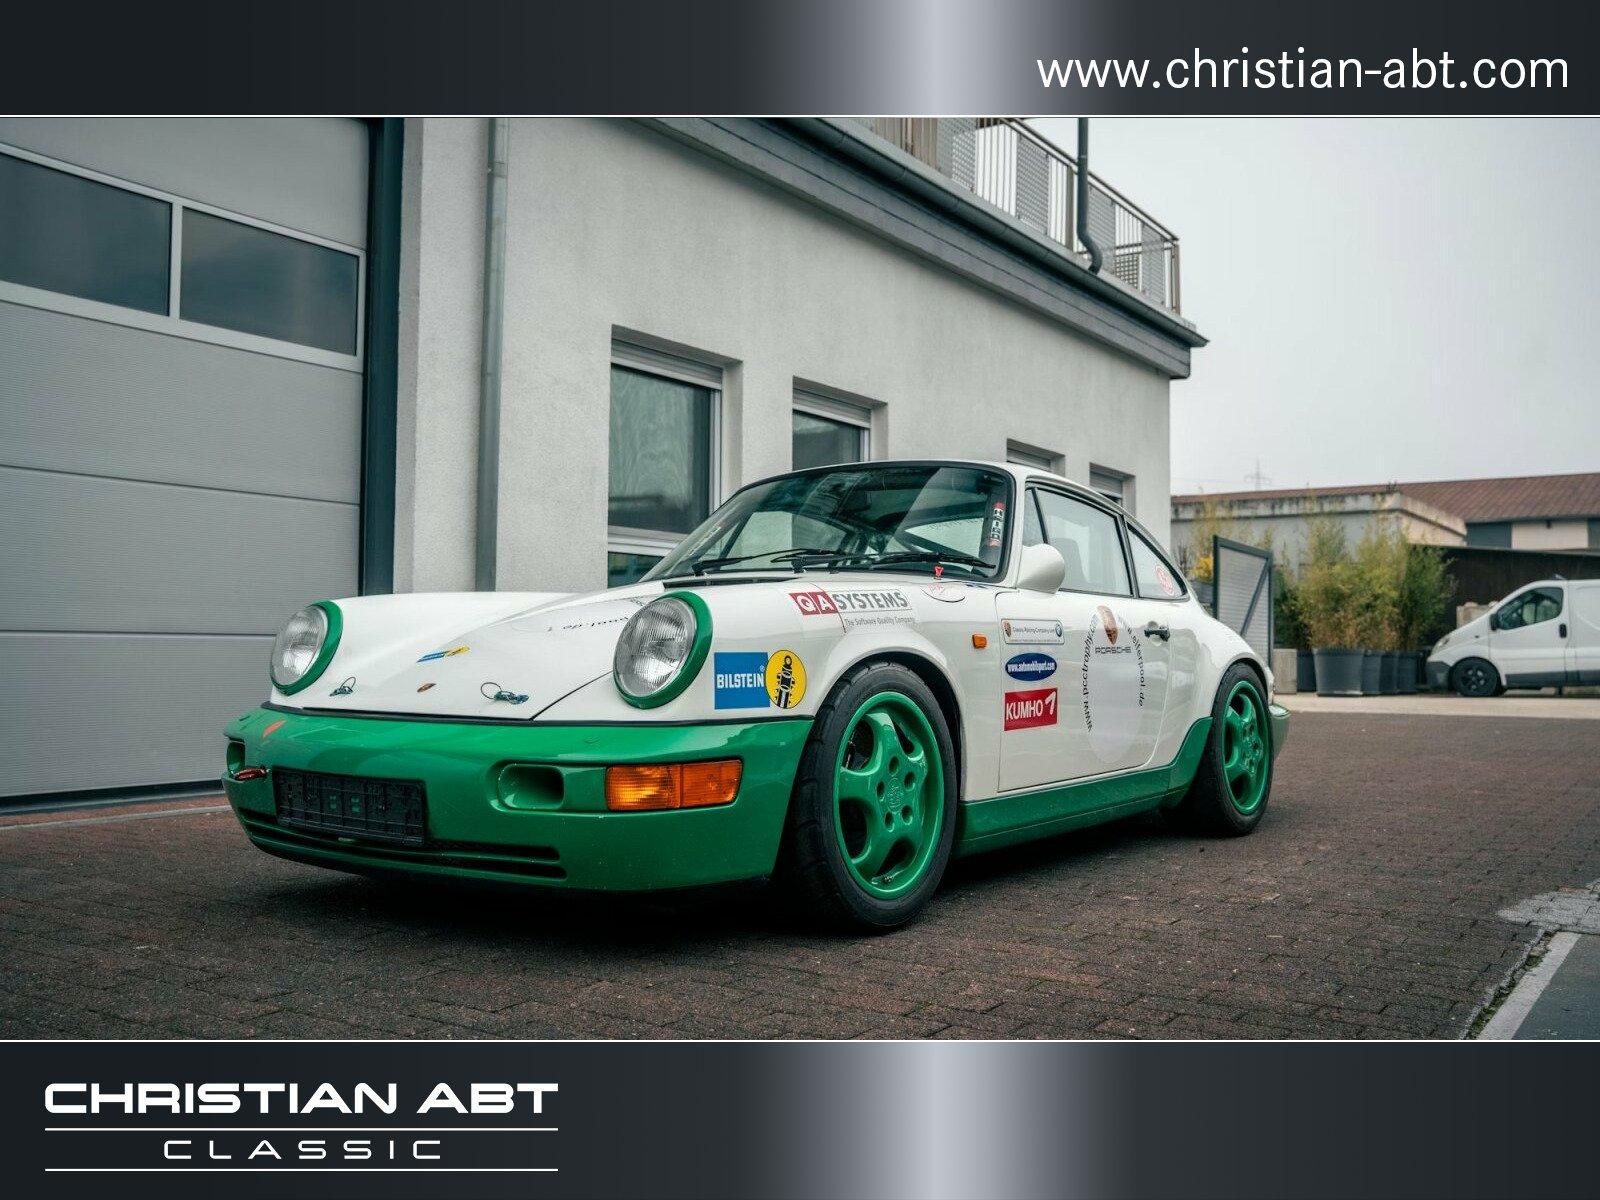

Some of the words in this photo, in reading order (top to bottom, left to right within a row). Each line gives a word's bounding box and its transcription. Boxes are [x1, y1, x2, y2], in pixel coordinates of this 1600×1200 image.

[796, 593, 834, 612] QA
[834, 591, 909, 611] SYSTEMS
[1095, 646, 1132, 654] PORSCHE
[716, 673, 765, 689] BILSTEIN
[1006, 699, 1044, 721] KUMHO
